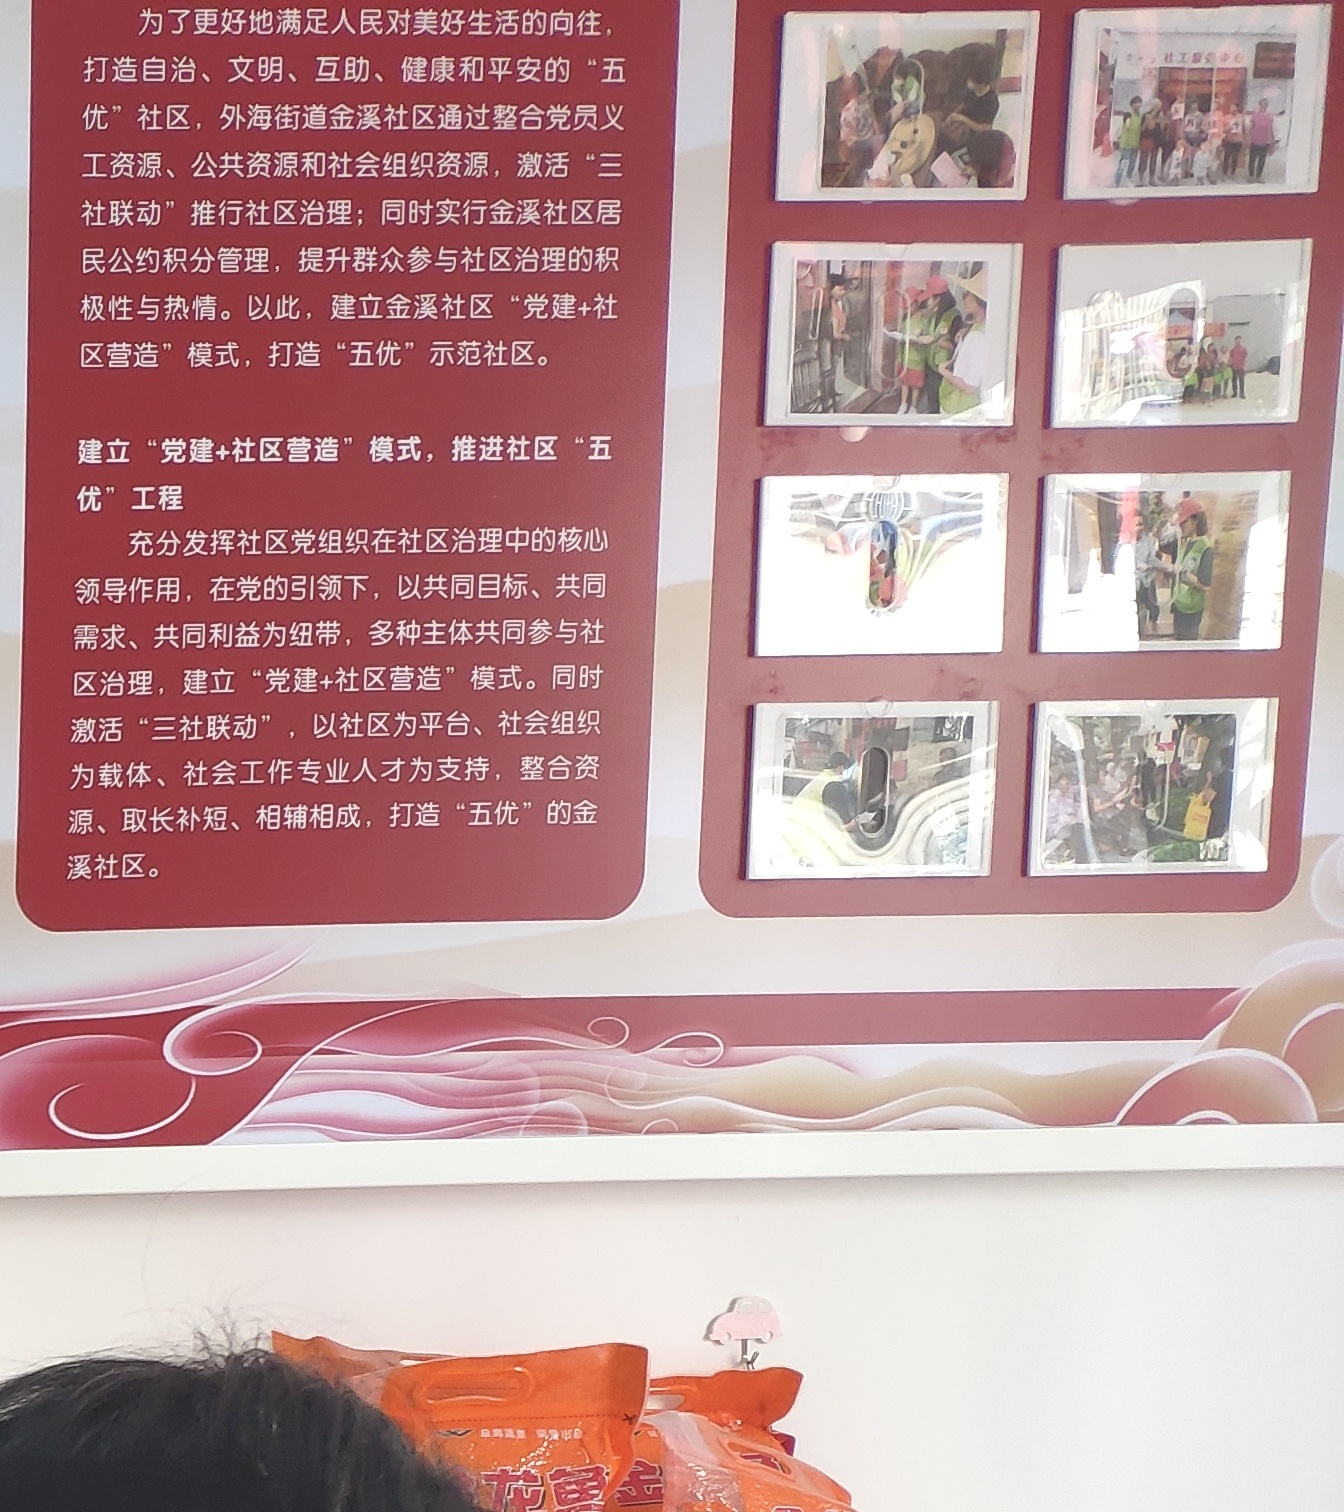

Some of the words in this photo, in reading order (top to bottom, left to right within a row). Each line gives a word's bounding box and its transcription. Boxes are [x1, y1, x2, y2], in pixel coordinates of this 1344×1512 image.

[138, 7, 612, 37] 为了更好地满足人民对美好生活的向往，
[81, 246, 620, 274] 民公约积分管理，提升群众参与社区治理的积
[128, 526, 609, 556] 充分发挥社区党组织在社区治理中的核心
[74, 573, 607, 604] 领导作用，在党的引领下，以共同目标、共同
[73, 619, 606, 650] 需求、共同利益为纽带，多种主体共同参与社
[69, 754, 600, 789] 为载体、社会工作专业人才为支持，整合资
[66, 854, 159, 880] 溪社区。
